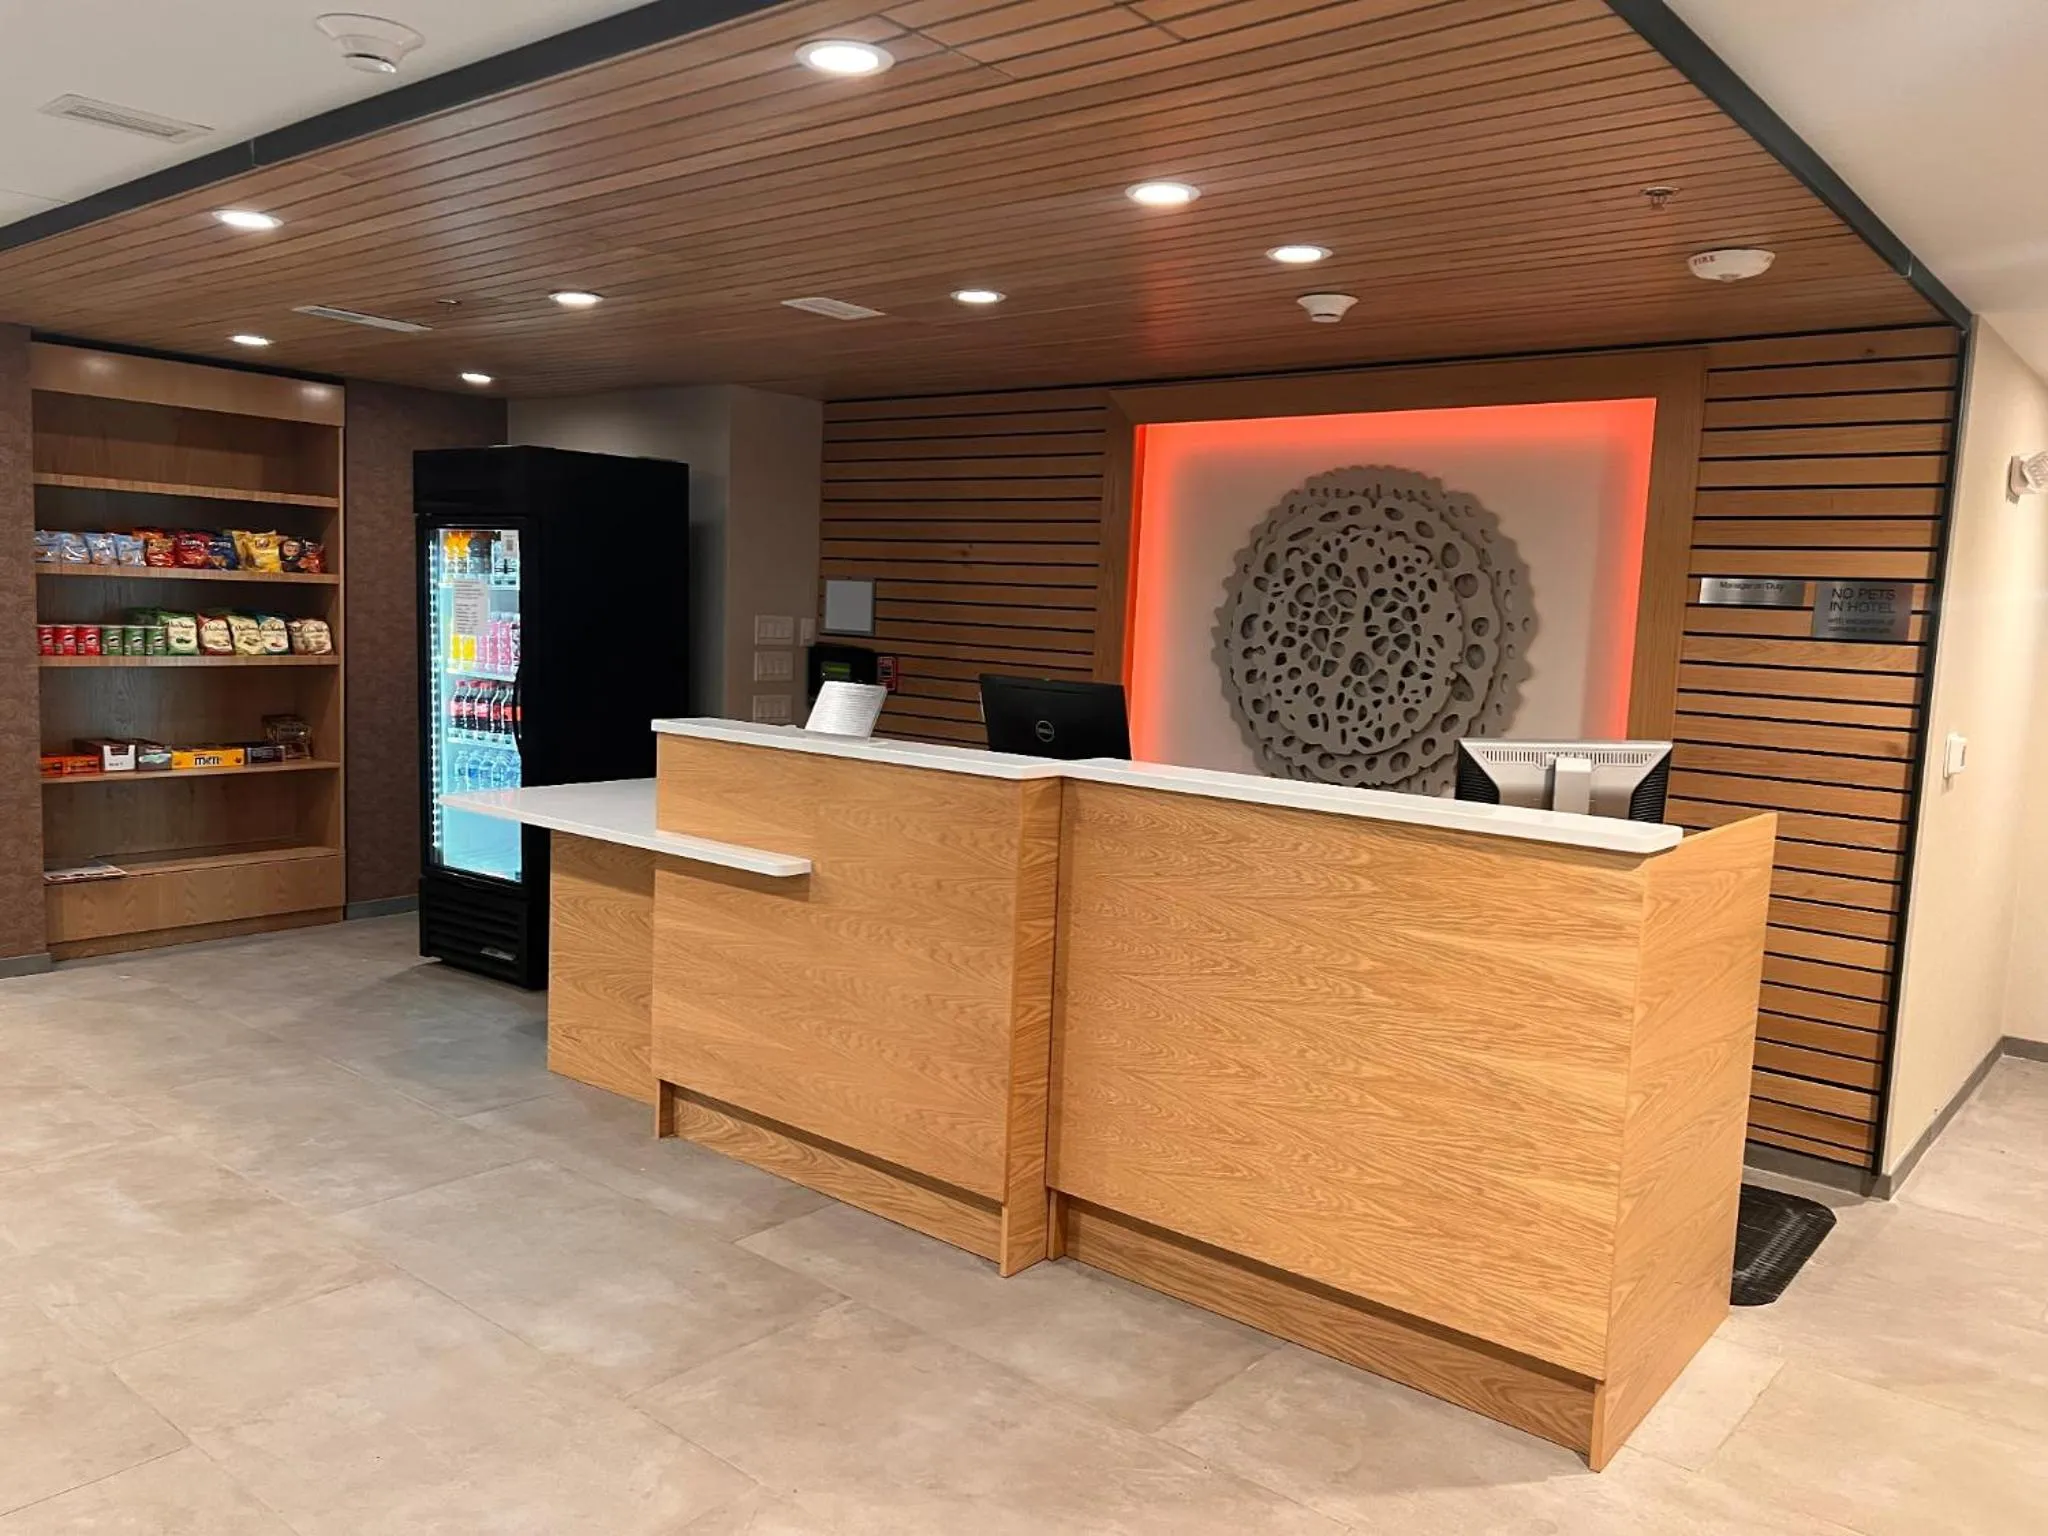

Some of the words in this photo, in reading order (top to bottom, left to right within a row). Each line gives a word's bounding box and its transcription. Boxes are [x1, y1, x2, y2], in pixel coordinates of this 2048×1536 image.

[1831, 587, 1854, 600] NO
[1858, 588, 1897, 601] PETS
[1829, 601, 1843, 612] IN
[1847, 602, 1896, 614] HOTEL
